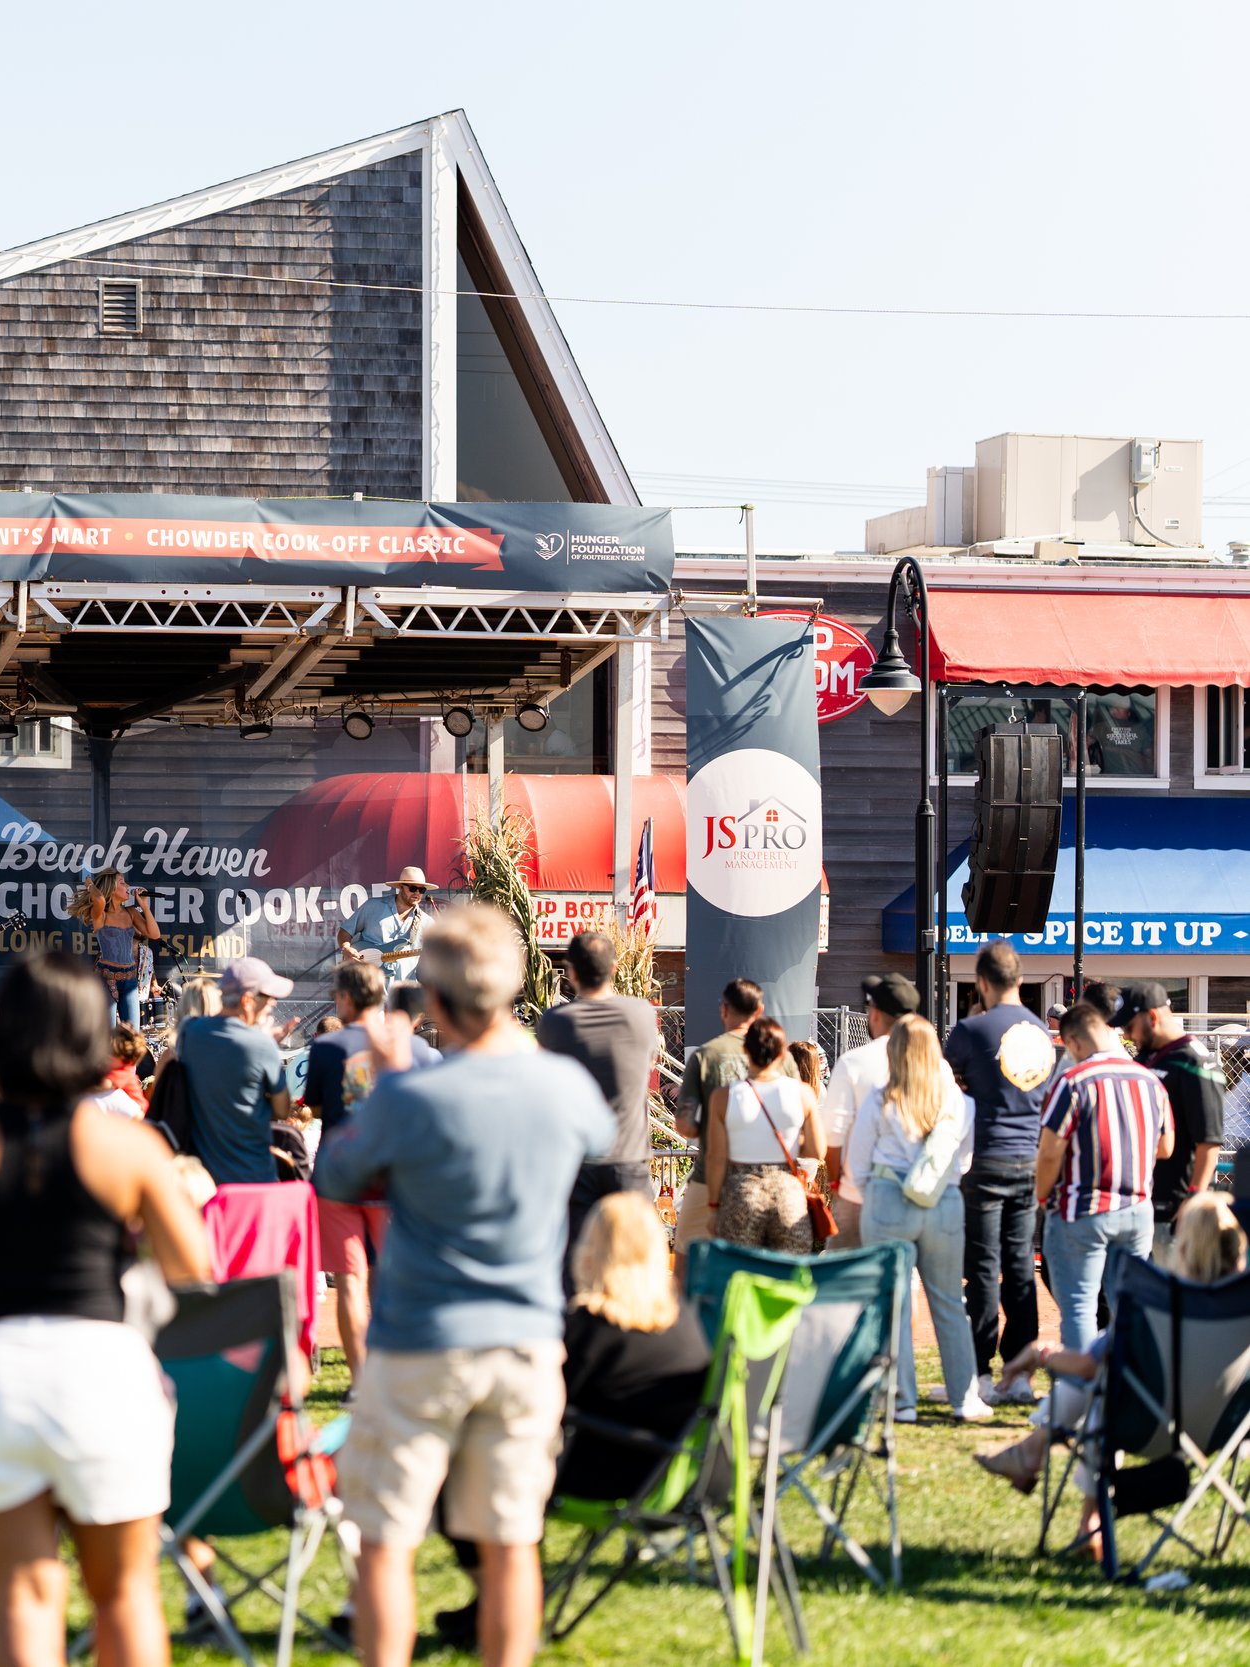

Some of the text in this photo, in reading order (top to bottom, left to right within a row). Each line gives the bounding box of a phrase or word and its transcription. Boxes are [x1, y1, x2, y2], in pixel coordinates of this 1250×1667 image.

[51, 526, 112, 545] MART
[147, 528, 255, 549] CHOWDER
[262, 532, 371, 553] COOK-OFF
[378, 535, 466, 555] CLASSIC
[571, 535, 620, 544] HUNGER
[571, 545, 645, 555] FOUNDATION
[0, 821, 271, 878] Beach Haven
[702, 816, 806, 859] JS PRO
[725, 861, 798, 869] MANAGEMENT
[733, 851, 790, 861] PROPERTY
[217, 883, 400, 926] COOK-O
[1131, 922, 1166, 945] IT
[1174, 922, 1221, 945] UP
[158, 934, 245, 959] ISLAND
